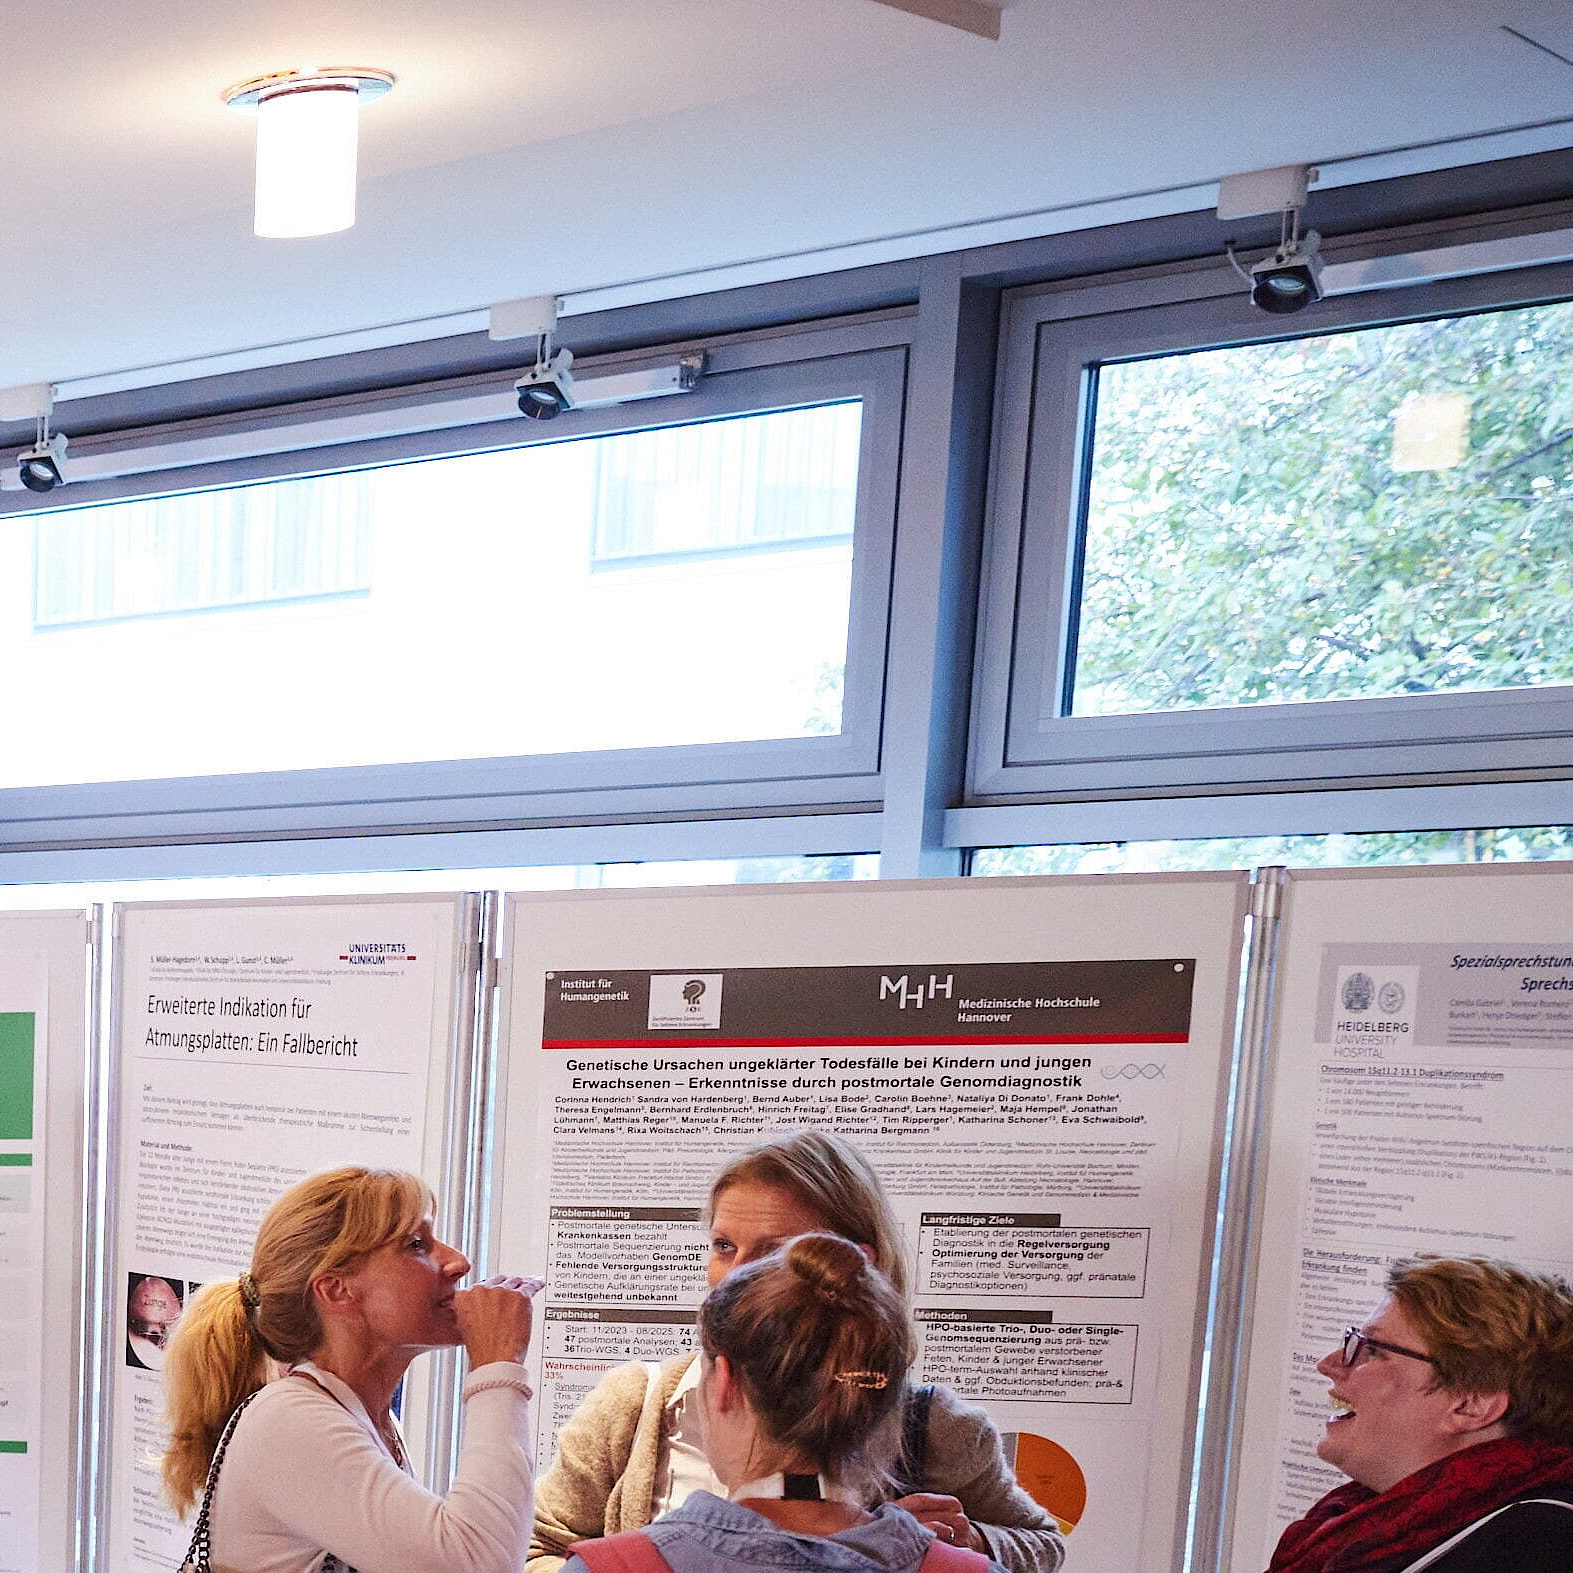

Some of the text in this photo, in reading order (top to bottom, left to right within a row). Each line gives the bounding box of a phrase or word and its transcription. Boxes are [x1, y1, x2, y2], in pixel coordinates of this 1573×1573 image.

[349, 956, 385, 964] KLINIKUM
[1451, 955, 1573, 969] Spezialsprechstun
[561, 979, 612, 989] Institut für
[560, 991, 630, 1003] Humangenetik
[880, 974, 953, 1009] MHH
[148, 996, 311, 1019] Erweiterte Indikation für
[958, 997, 1100, 1009] Medizinische Hochschule
[957, 1012, 1011, 1022] Hannover
[1337, 1022, 1409, 1033] HEIDELBERG
[146, 1028, 358, 1057] Atmungsplatten: Ein Fallbericht
[1335, 1035, 1398, 1045] UNIVERSITY
[1334, 1048, 1385, 1058] HOSPITAL
[566, 1057, 1091, 1073] Genetische Ursachen ungeklärter Todesfälle bei Kindern und jungen
[572, 1076, 1082, 1090] Erwachsenen Erkenntnisse durch postmortale Genomdiagnostik
[551, 1209, 630, 1220] Problemstellung
[922, 1215, 1014, 1226] Langfristige Ziele
[558, 1221, 663, 1232] Postmortale genetische
[558, 1231, 667, 1241] Krankenkassen bezahlt
[934, 1229, 990, 1239] Etablierung
[1012, 1230, 1077, 1241] postmortalen
[1081, 1231, 1142, 1240] genetischen
[557, 1242, 709, 1253] Postmortale Sequenzierung nicht
[933, 1238, 1110, 1251] Diagnostik Regelversorgung
[578, 1252, 649, 1261] Modellvorhaben
[653, 1253, 702, 1261] GenomDE
[932, 1249, 998, 1260] Optimierung
[1001, 1250, 1018, 1258] der
[1022, 1251, 1084, 1262] Versorgung
[556, 1262, 598, 1270] Fehlende
[932, 1260, 973, 1269] Familien
[614, 1272, 627, 1280] die
[645, 1273, 666, 1281] einer
[930, 1270, 1000, 1281] psychosoziale
[1089, 1272, 1136, 1282] pränatale
[555, 1281, 694, 1293] Genetische Aufklärungsrate bei
[554, 1291, 677, 1302] weitestgehend unbekannt
[546, 1310, 599, 1320] Ergebnisse
[914, 1311, 968, 1320] Methoden
[926, 1324, 1123, 1337] HPO-basierte Trio-, Duo- oder Single-
[578, 1337, 630, 1346] postmortale
[926, 1334, 1041, 1346] Genomsequenzierung
[1066, 1336, 1086, 1346] prä-
[1089, 1337, 1110, 1346] bzw.
[925, 1345, 1102, 1356] postmortalem Gewebe verstorbener
[958, 1355, 989, 1364] Kinder
[1002, 1356, 1034, 1367] junger
[1038, 1358, 1103, 1366] Erwachsener
[923, 1364, 1108, 1377] HPO-term-Auswahl anhand klinischer
[922, 1375, 952, 1384] Daten
[964, 1376, 982, 1386] ggf.
[982, 1386, 1066, 1398] Photoaufnahmen
